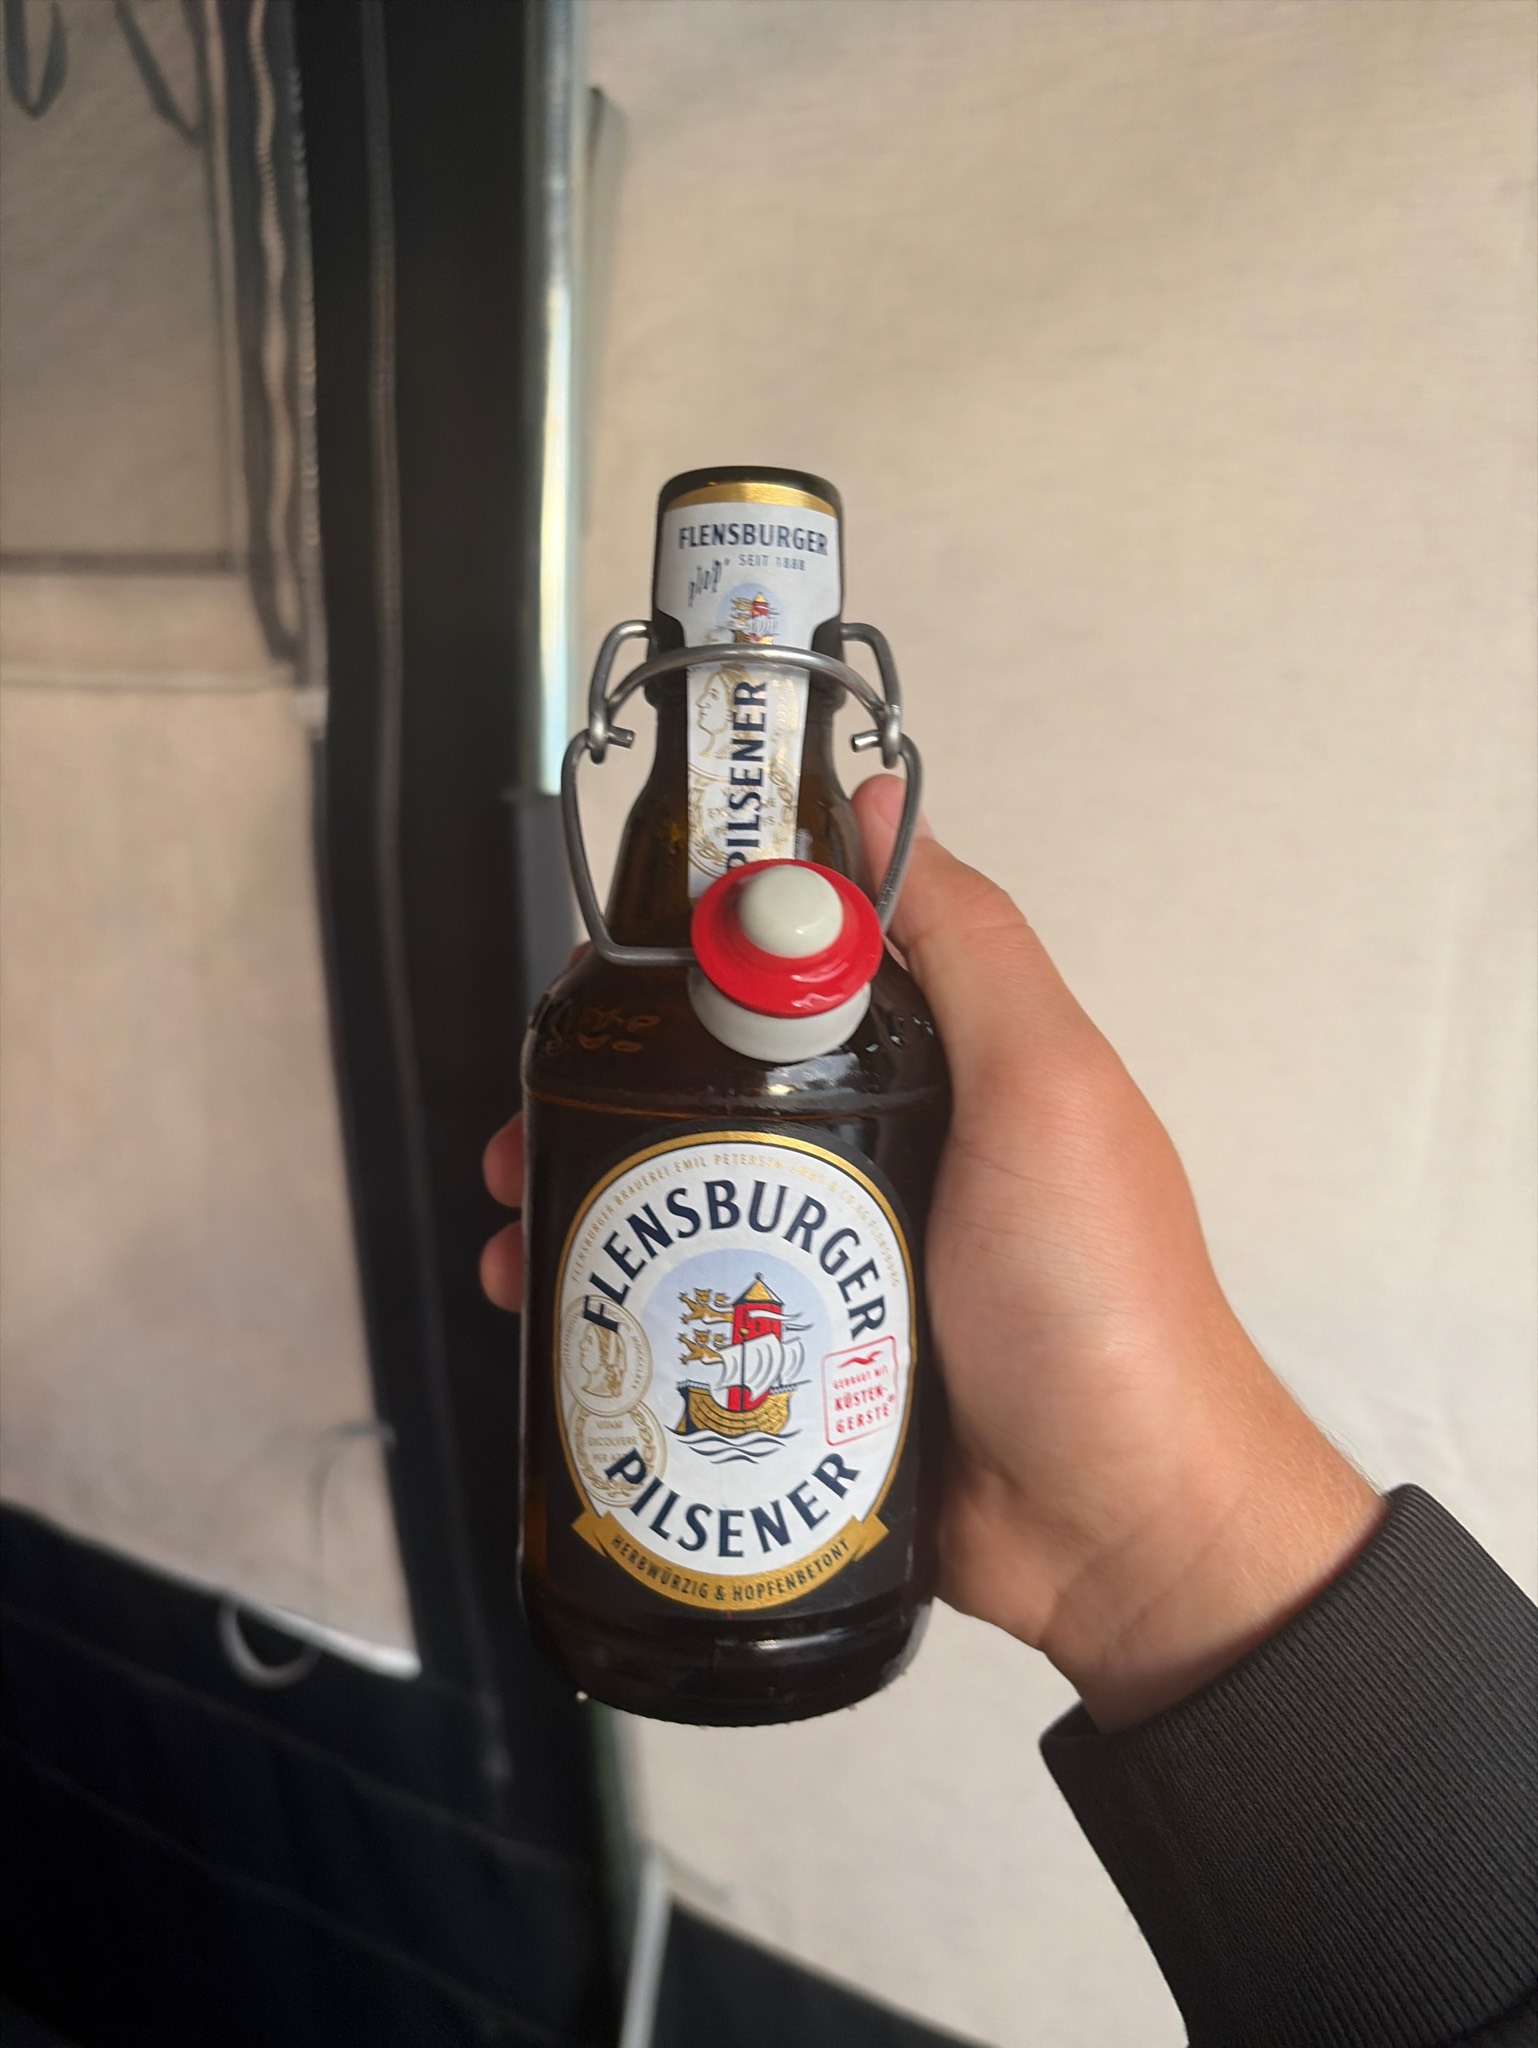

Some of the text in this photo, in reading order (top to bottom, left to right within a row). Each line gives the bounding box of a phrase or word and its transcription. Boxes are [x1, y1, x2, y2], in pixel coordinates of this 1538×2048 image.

[679, 523, 828, 555] FLENSBURGER
[738, 554, 769, 567] SEIT
[726, 682, 767, 870] PILSENER
[673, 1156, 706, 1173] EMIL
[583, 1179, 887, 1340] FLENSBURGER
[604, 1447, 861, 1558] PILSENER
[610, 1533, 850, 1602] HERBWÜRZIG & HOPFENBETONT
